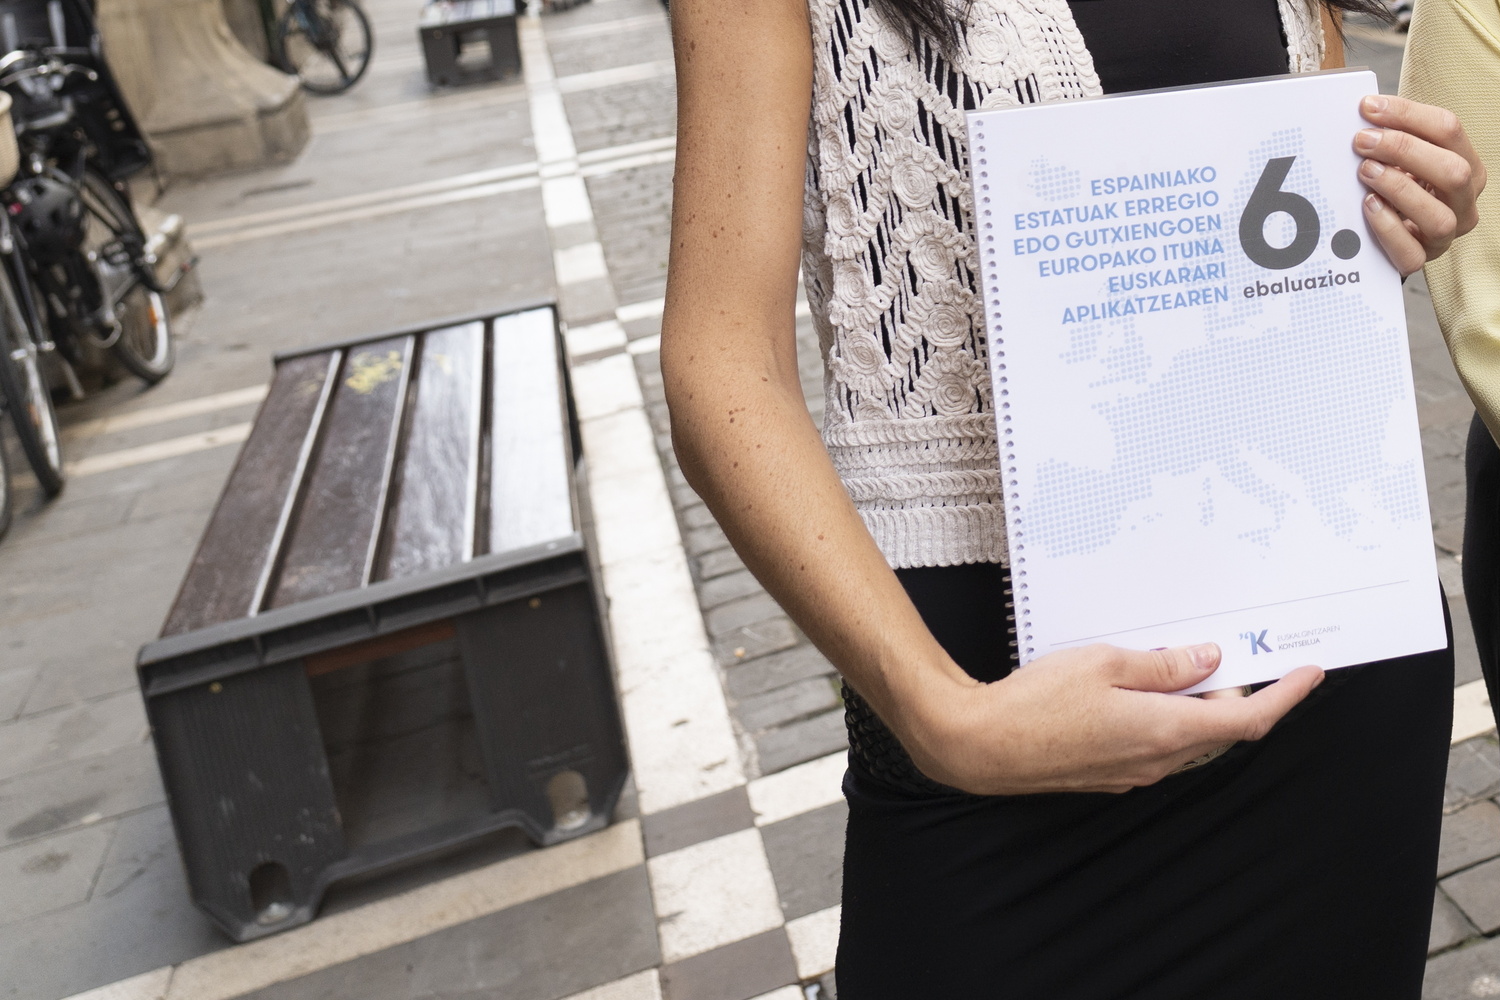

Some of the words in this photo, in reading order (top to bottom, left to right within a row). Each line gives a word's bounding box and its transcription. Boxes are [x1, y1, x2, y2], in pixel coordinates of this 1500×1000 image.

[1090, 166, 1217, 196] ESPAINIAKO
[1014, 202, 1119, 231] ESTATUAK
[1125, 190, 1219, 217] ERREGIO
[1239, 156, 1361, 270] 6.
[1013, 234, 1060, 256] EDO
[1065, 214, 1222, 249] GUTXIENGOEN
[1039, 247, 1156, 277] EUROPAKO
[1162, 238, 1224, 261] ITUNA
[1108, 261, 1226, 293] EUSKARARI
[1243, 269, 1361, 299] ebaluazioa
[1062, 285, 1229, 325] APLIKATZEAREN
[1278, 638, 1321, 650] KONTSEILUA
